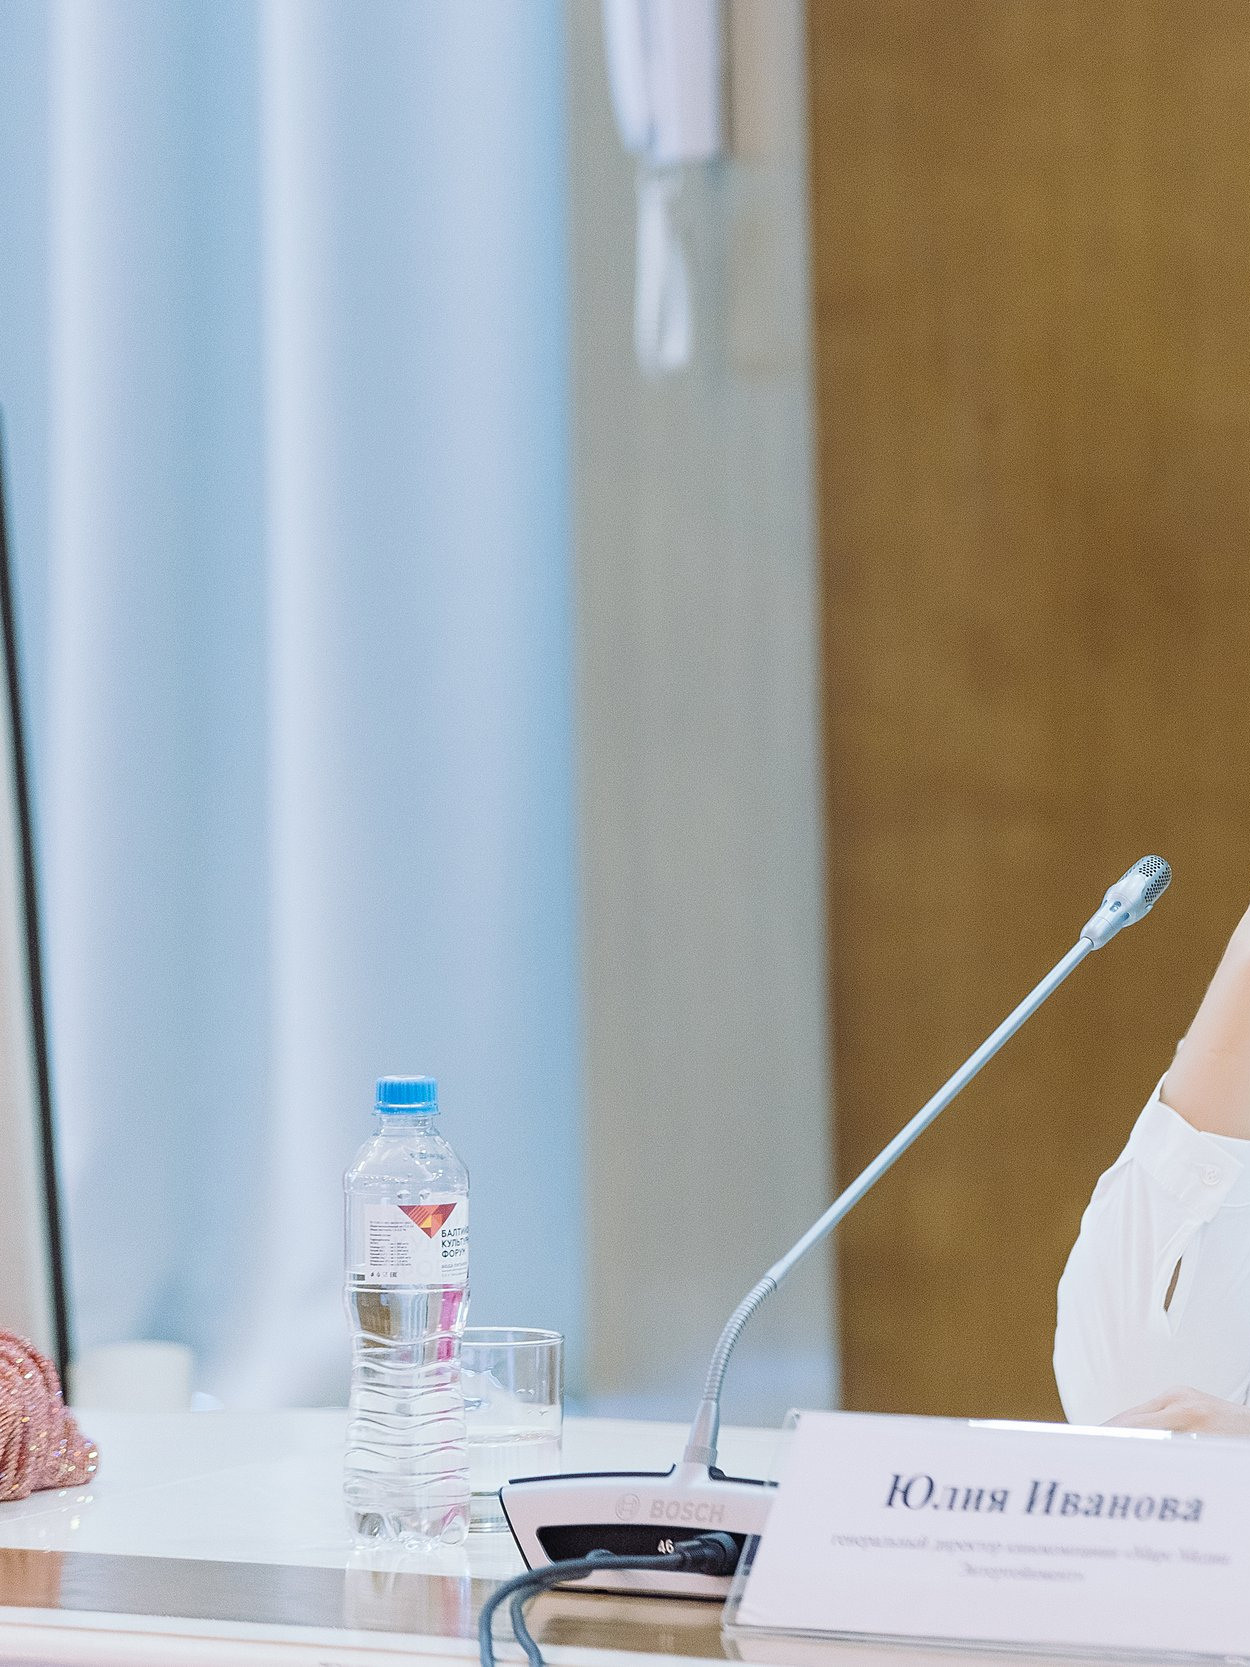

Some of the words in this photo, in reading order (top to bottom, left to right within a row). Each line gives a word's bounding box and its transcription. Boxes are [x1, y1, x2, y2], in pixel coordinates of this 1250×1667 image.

[884, 1472, 1011, 1514] Юлия
[1024, 1478, 1205, 1523] Иванова
[650, 1499, 725, 1523] BOSCH
[657, 1538, 675, 1555] 46
